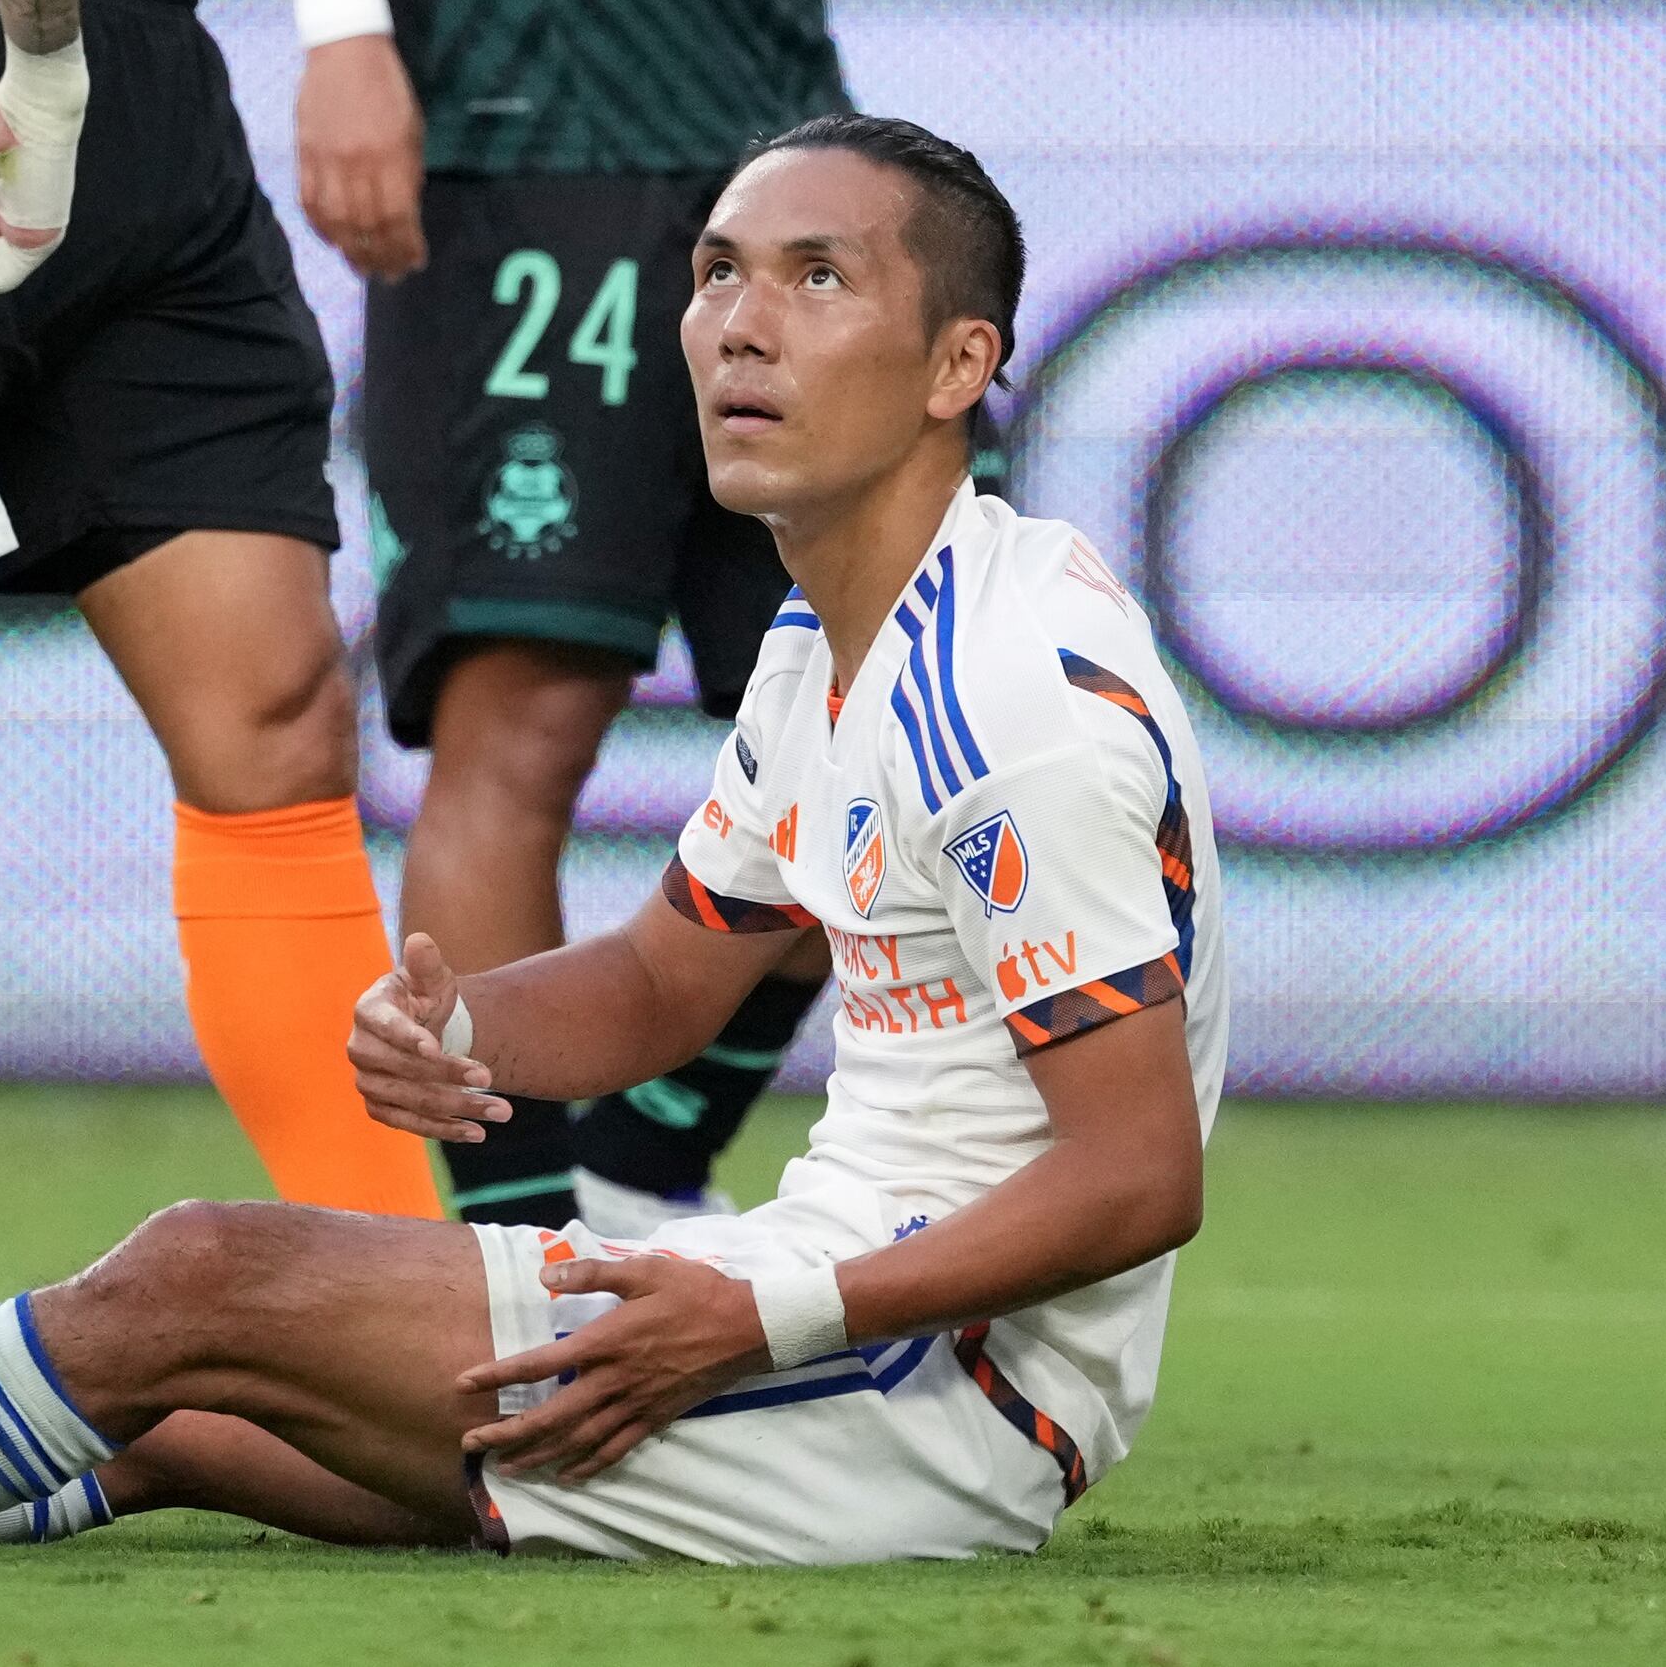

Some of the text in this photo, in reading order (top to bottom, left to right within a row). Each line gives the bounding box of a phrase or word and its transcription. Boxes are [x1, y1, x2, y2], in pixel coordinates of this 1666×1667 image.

[485, 249, 641, 407] 24
[956, 832, 992, 864] MLS
[1020, 930, 1078, 987] tv
